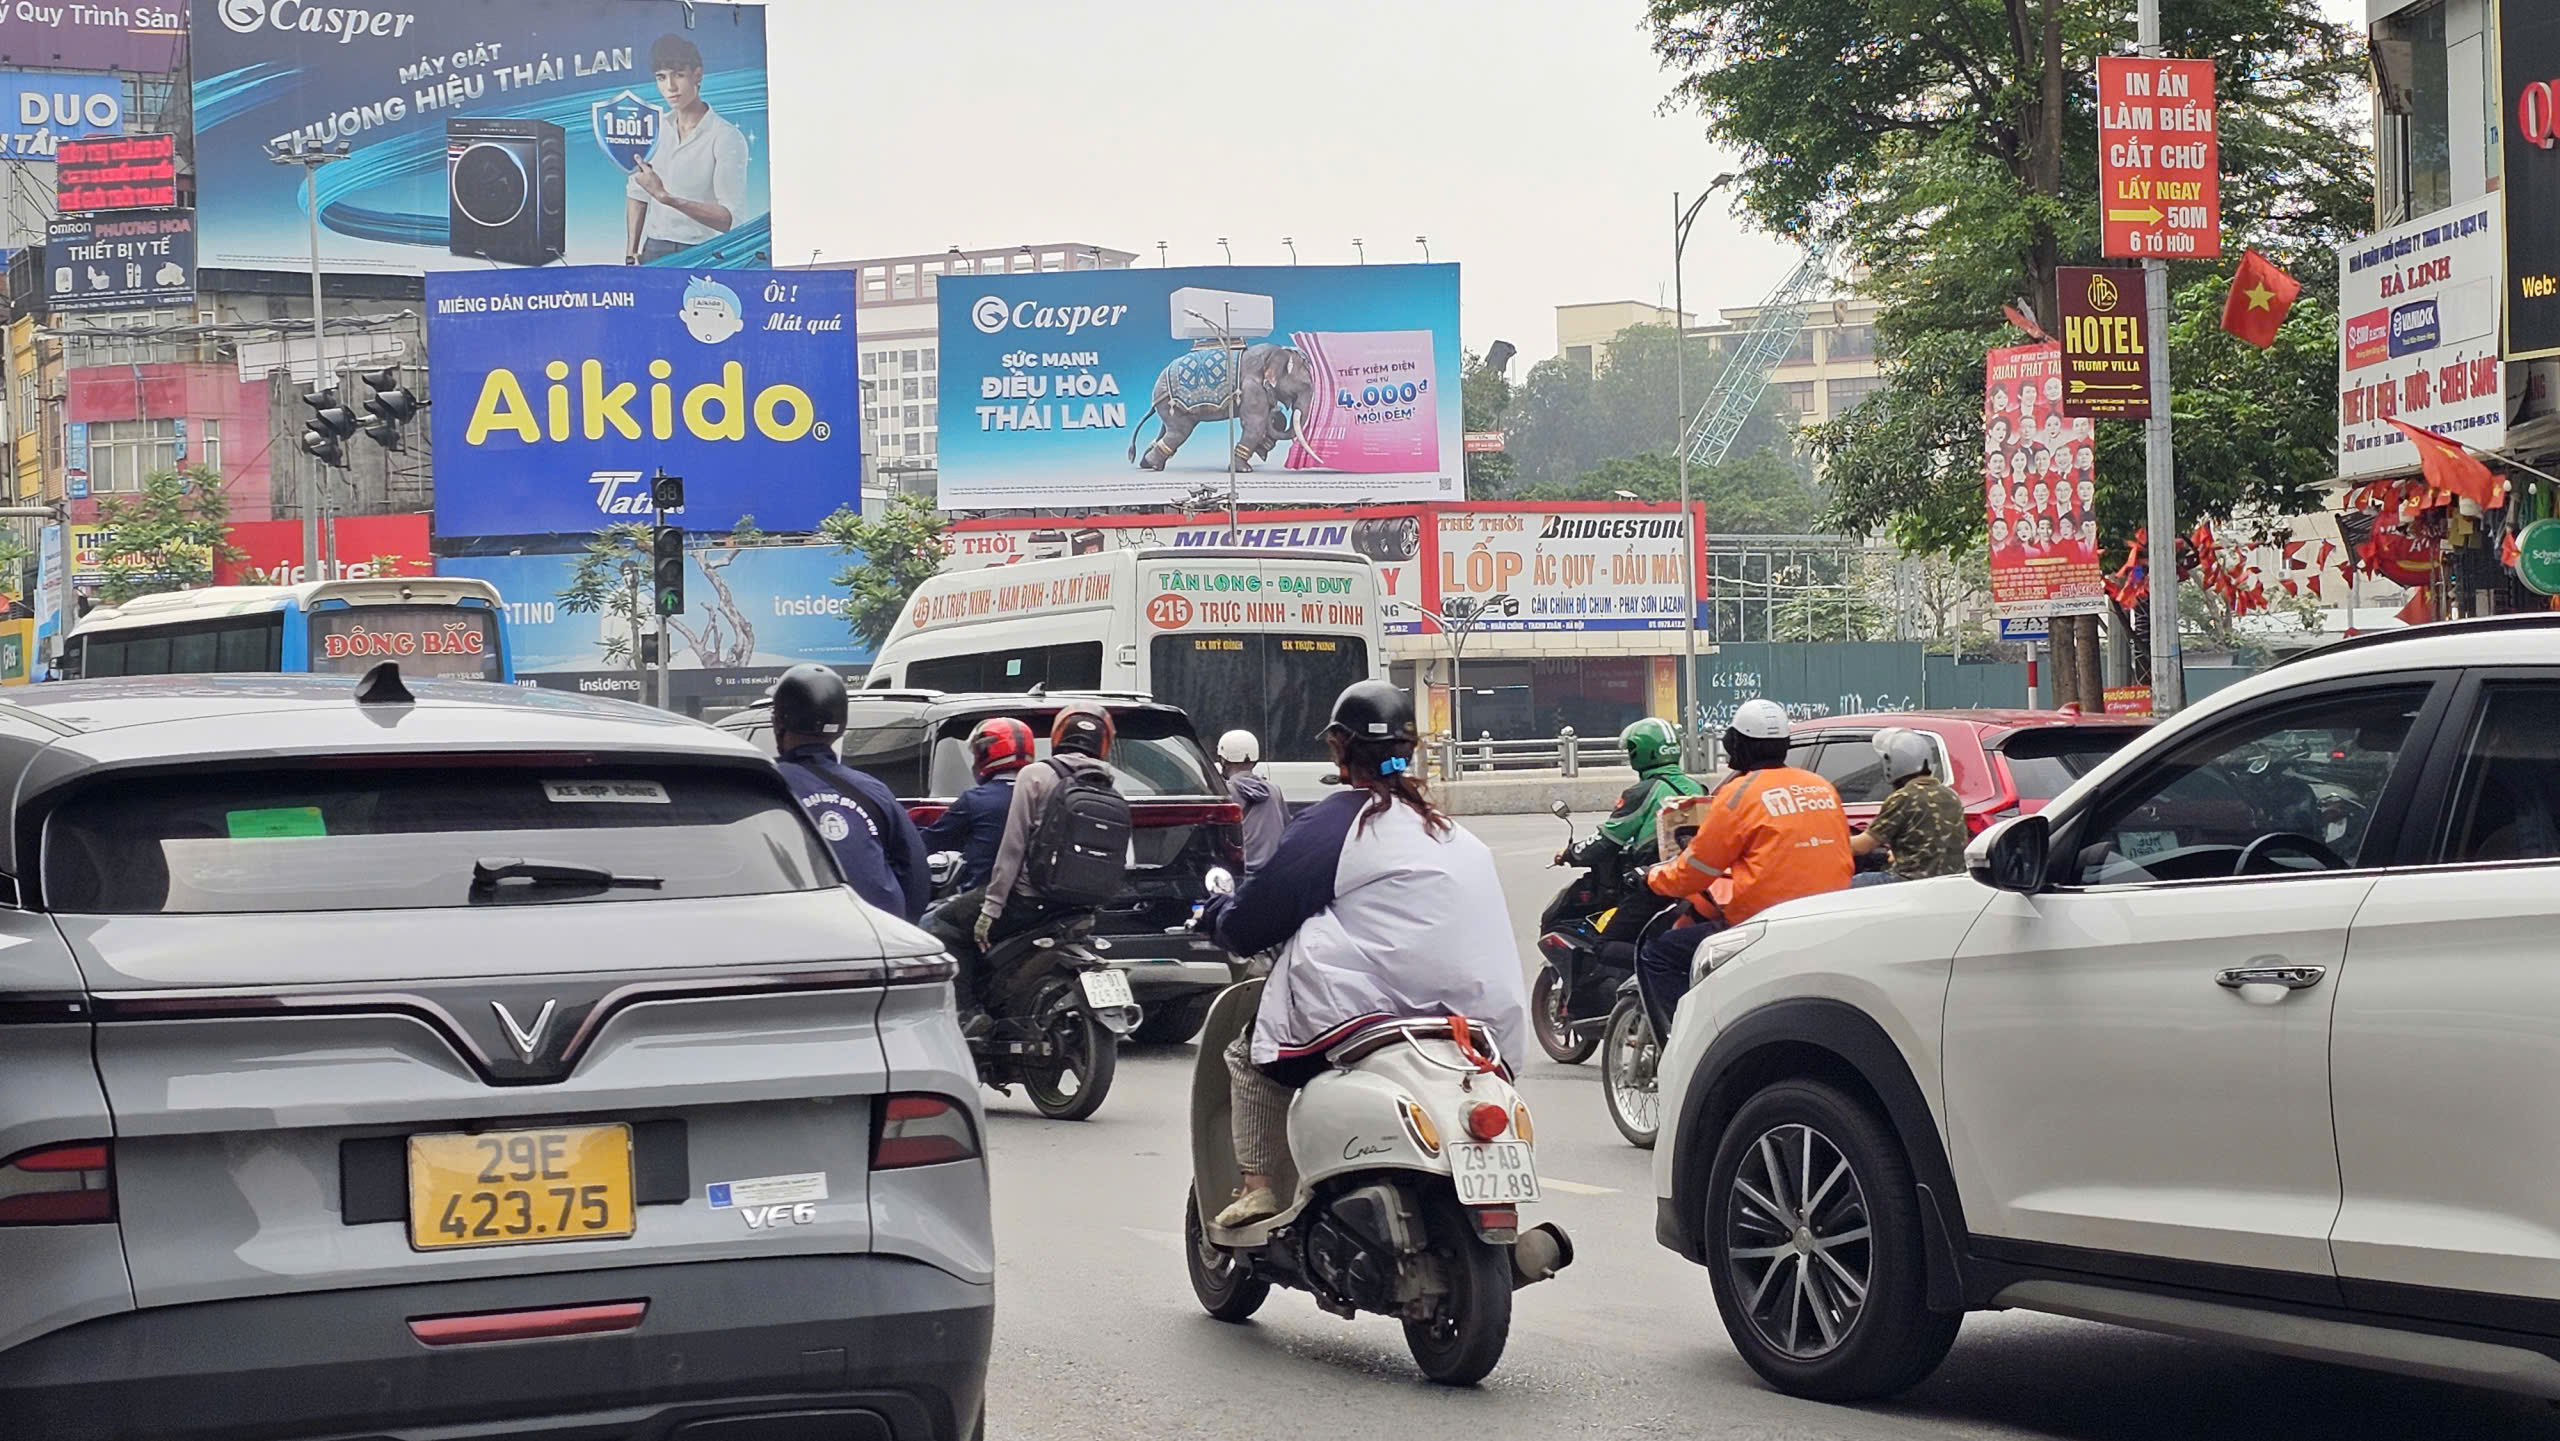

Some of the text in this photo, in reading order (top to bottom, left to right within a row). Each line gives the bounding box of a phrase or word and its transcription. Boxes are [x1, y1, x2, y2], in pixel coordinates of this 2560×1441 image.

[16, 2, 63, 27] Quy
[69, 5, 129, 27] Trình
[135, 7, 178, 28] Sản
[270, 0, 414, 43] Casper
[399, 42, 502, 84] MÁY GIẶT
[416, 73, 484, 111] HIỆU
[493, 53, 565, 93] THÁI
[575, 48, 633, 78] LAN
[2126, 66, 2188, 97] IN ẤN
[20, 92, 118, 127] DUO
[2104, 99, 2212, 132] LÀM BIỂN
[604, 112, 653, 136] 1 ĐỔI 1
[2110, 135, 2207, 169] CẮT CHỮ
[2118, 174, 2201, 200] LẤY NGAY
[49, 218, 191, 238] OMRON PHƯƠNG HOA
[2167, 206, 2208, 228] 50M
[68, 235, 172, 261] THIẾT BỊ Y TẾ
[2130, 229, 2195, 252] 6 TỐ HỮU
[2380, 256, 2451, 298] HÀ LINH
[2522, 275, 2556, 298] Web:
[490, 294, 523, 311] DÁN
[527, 291, 588, 310] CHƯỜM
[592, 292, 634, 309] LẠNH
[763, 280, 786, 302] Ôi
[763, 312, 841, 335] Mát quá
[1012, 301, 1127, 335] Casper
[2065, 316, 2144, 354] HOTEL
[1002, 350, 1099, 370] SỨC MẠNH
[1338, 366, 1360, 376] TIẾT
[1392, 361, 1416, 372] ĐIỆN
[2072, 360, 2140, 372] TRUMP VILLA
[981, 368, 1120, 398] ĐIỀU HÒA
[2342, 377, 2365, 426] THIẾT
[2405, 357, 2430, 413] NƯỚC
[2440, 351, 2467, 405] CHIẾU
[2470, 351, 2497, 398] SÁNG
[465, 358, 814, 447] Aikido
[975, 398, 1127, 431] THÁI LAN
[1440, 512, 1475, 531] THẾ
[1480, 514, 1524, 531] THỜI
[962, 533, 1016, 554] THỜI
[1174, 526, 1348, 547] MICHELIN
[1442, 536, 1523, 593] LỐP
[1533, 543, 1557, 585] ẮC
[1562, 554, 1596, 588] QUY
[932, 570, 1110, 622] BX.TRỰC NINH NAM ĐỊNH BX.MỸ ĐÌNH
[1159, 569, 1352, 597] TÂN LONG ĐẠI DUY
[1153, 600, 1187, 622] 215
[1200, 600, 1240, 627] TRỰC
[1247, 603, 1285, 623] NINH
[1302, 601, 1324, 623] MỸ
[1328, 603, 1363, 625] ĐÌNH
[1619, 596, 1639, 613] PHAY
[325, 622, 483, 657] ĐÔNG BẮC
[1795, 794, 1837, 813] Food
[477, 1135, 569, 1184] 29E
[1462, 1146, 1521, 1171] 29-AB
[1461, 1173, 1535, 1199] 027.89
[440, 1185, 609, 1239] 423.75
[740, 1203, 817, 1229] VF6
